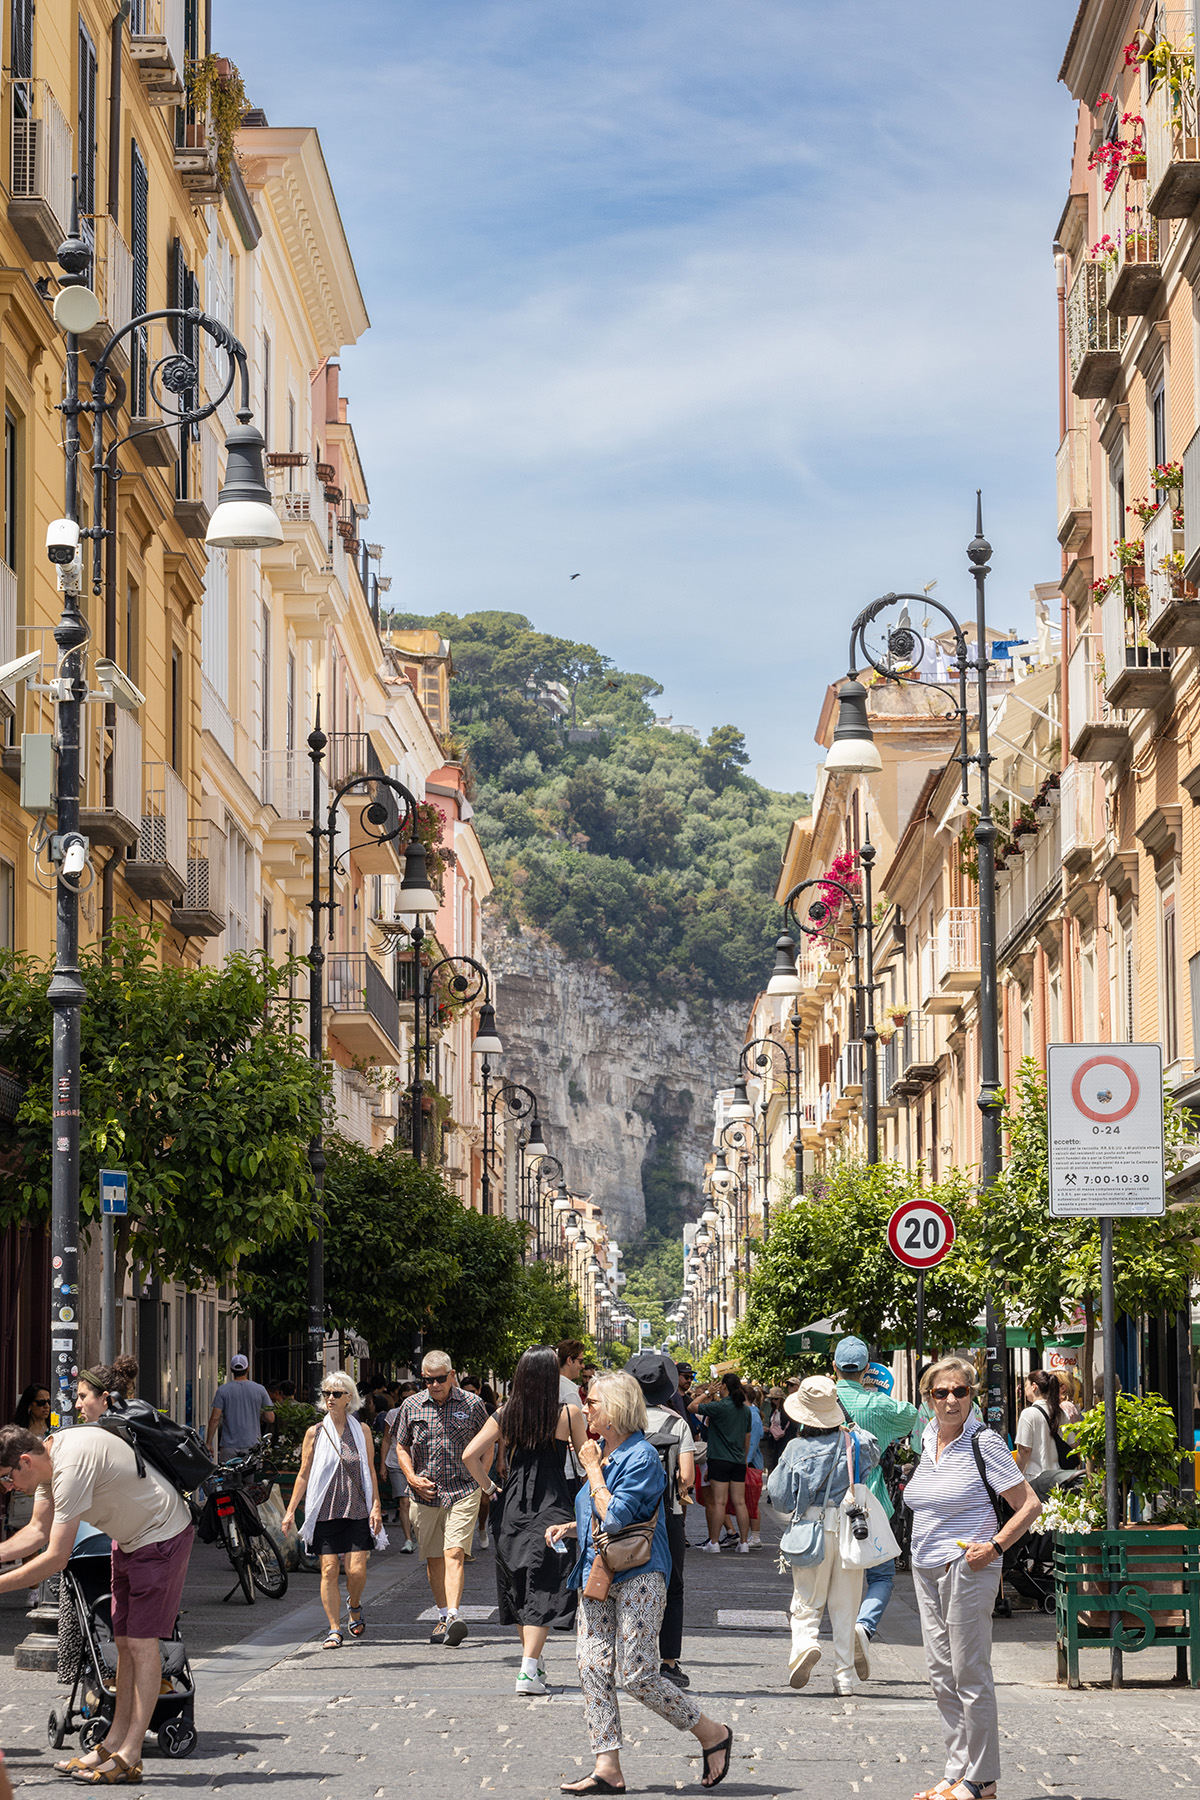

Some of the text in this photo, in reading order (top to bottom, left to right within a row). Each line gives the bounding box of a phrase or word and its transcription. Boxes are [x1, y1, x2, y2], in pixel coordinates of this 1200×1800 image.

[1092, 1126, 1120, 1135] 0-24
[1084, 1175, 1149, 1184] 7:00-10:30
[904, 1217, 940, 1250] 20
